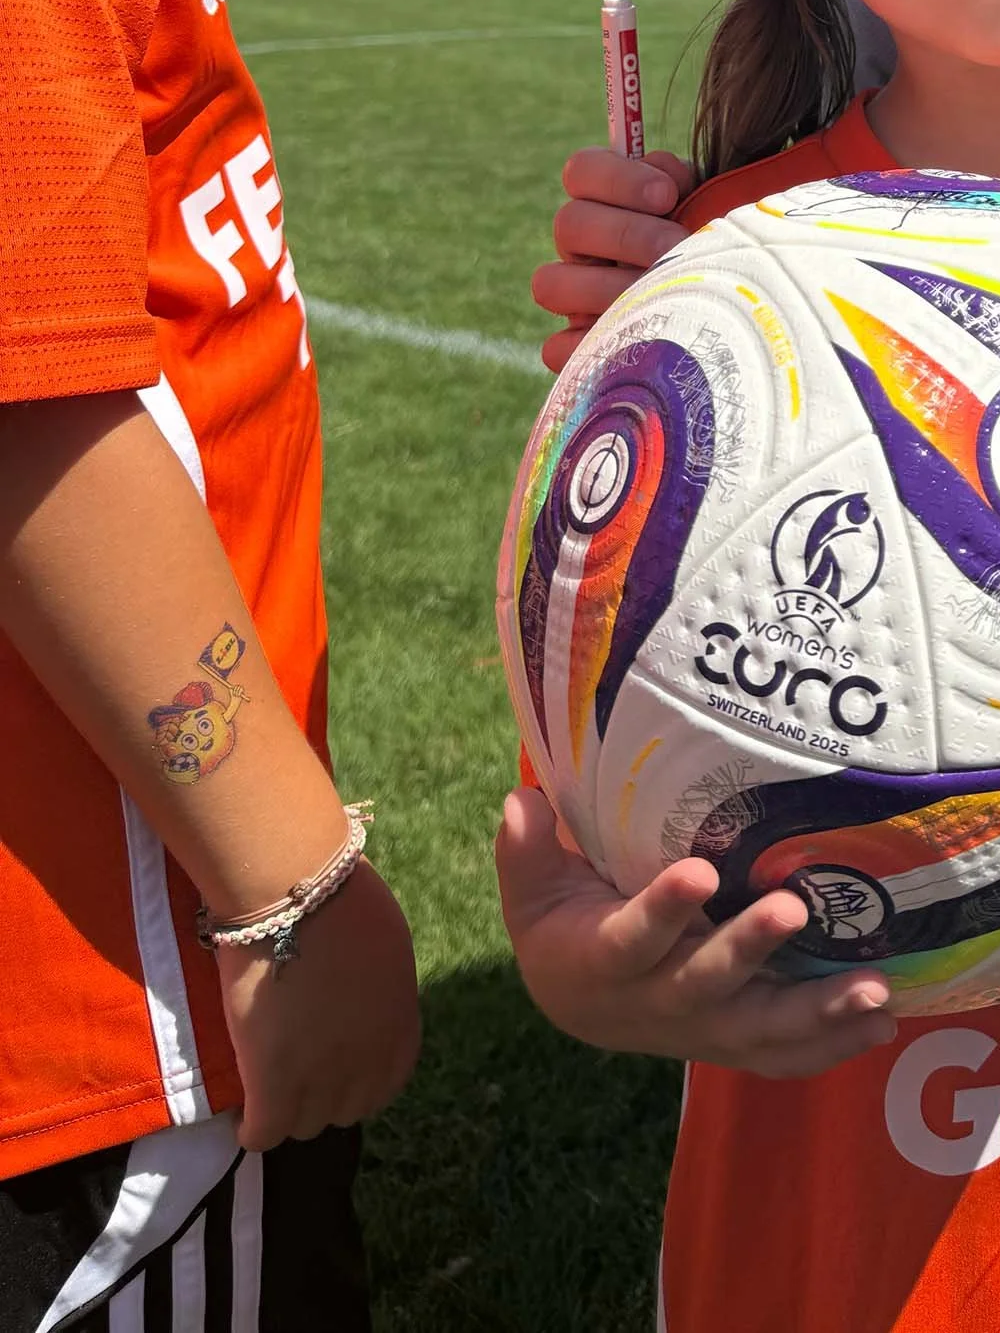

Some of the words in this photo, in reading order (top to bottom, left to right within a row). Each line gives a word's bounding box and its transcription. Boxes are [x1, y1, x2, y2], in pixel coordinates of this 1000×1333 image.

[623, 53, 641, 113] 400
[775, 596, 836, 634] UEFA
[707, 694, 806, 742] SWITZERLAND
[809, 733, 850, 758] 2025
